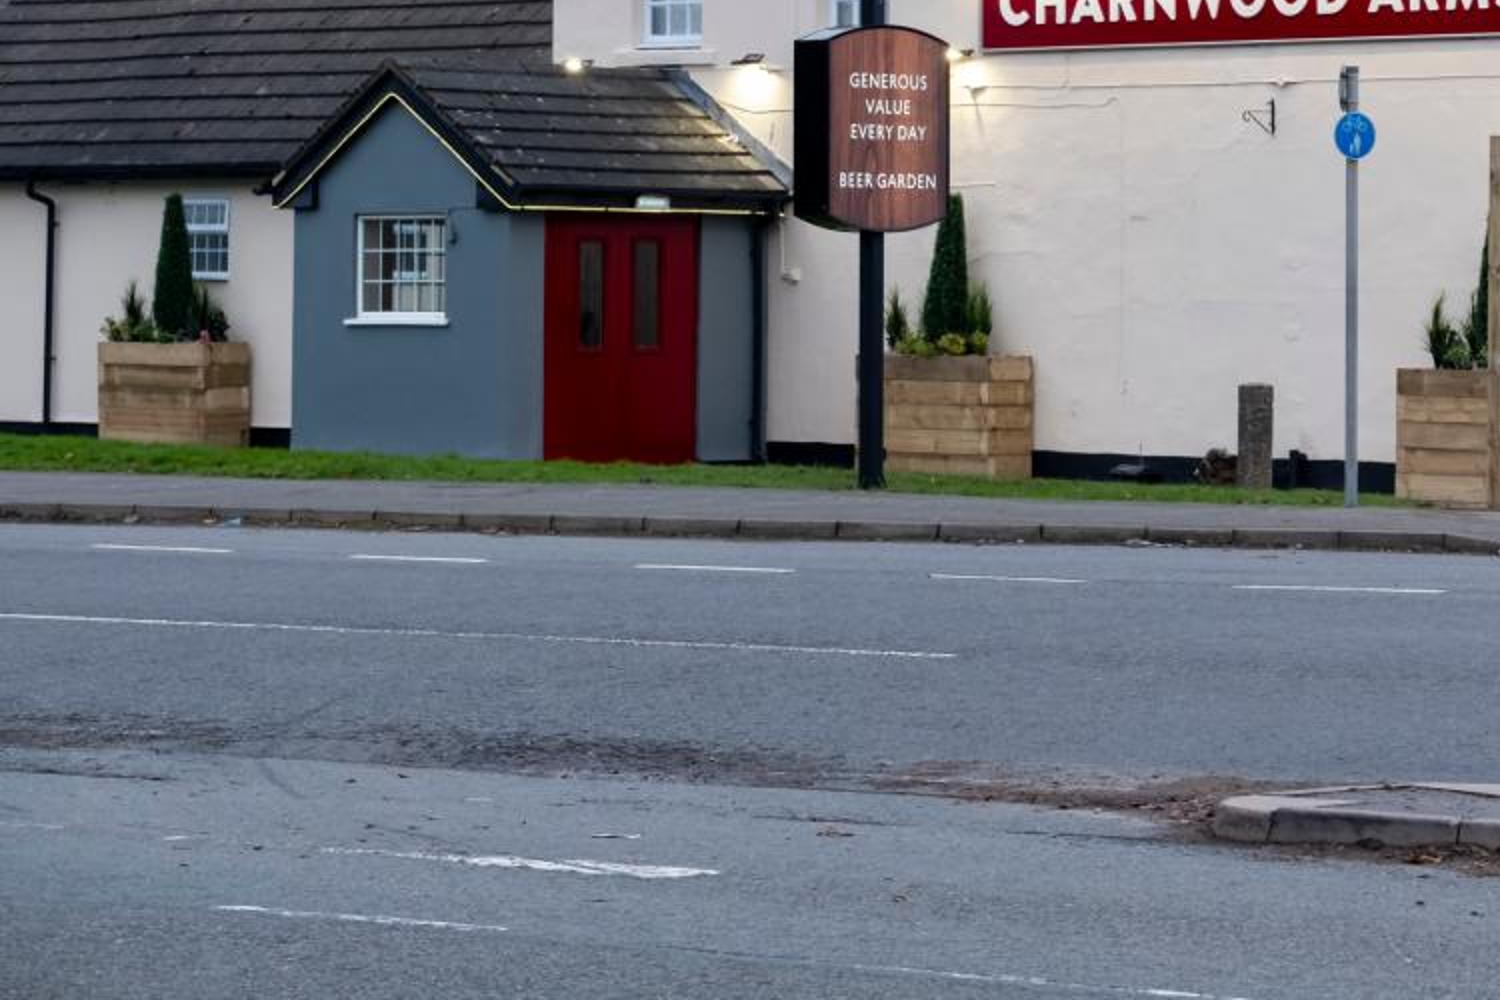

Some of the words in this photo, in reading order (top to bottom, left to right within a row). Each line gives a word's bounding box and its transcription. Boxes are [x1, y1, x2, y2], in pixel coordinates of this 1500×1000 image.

[849, 72, 928, 91] GENEROUS
[865, 99, 911, 115] VALUE
[850, 123, 893, 140] EVERY
[897, 125, 927, 140] DAY
[840, 172, 873, 188] BEER
[877, 173, 937, 190] GARDEN
